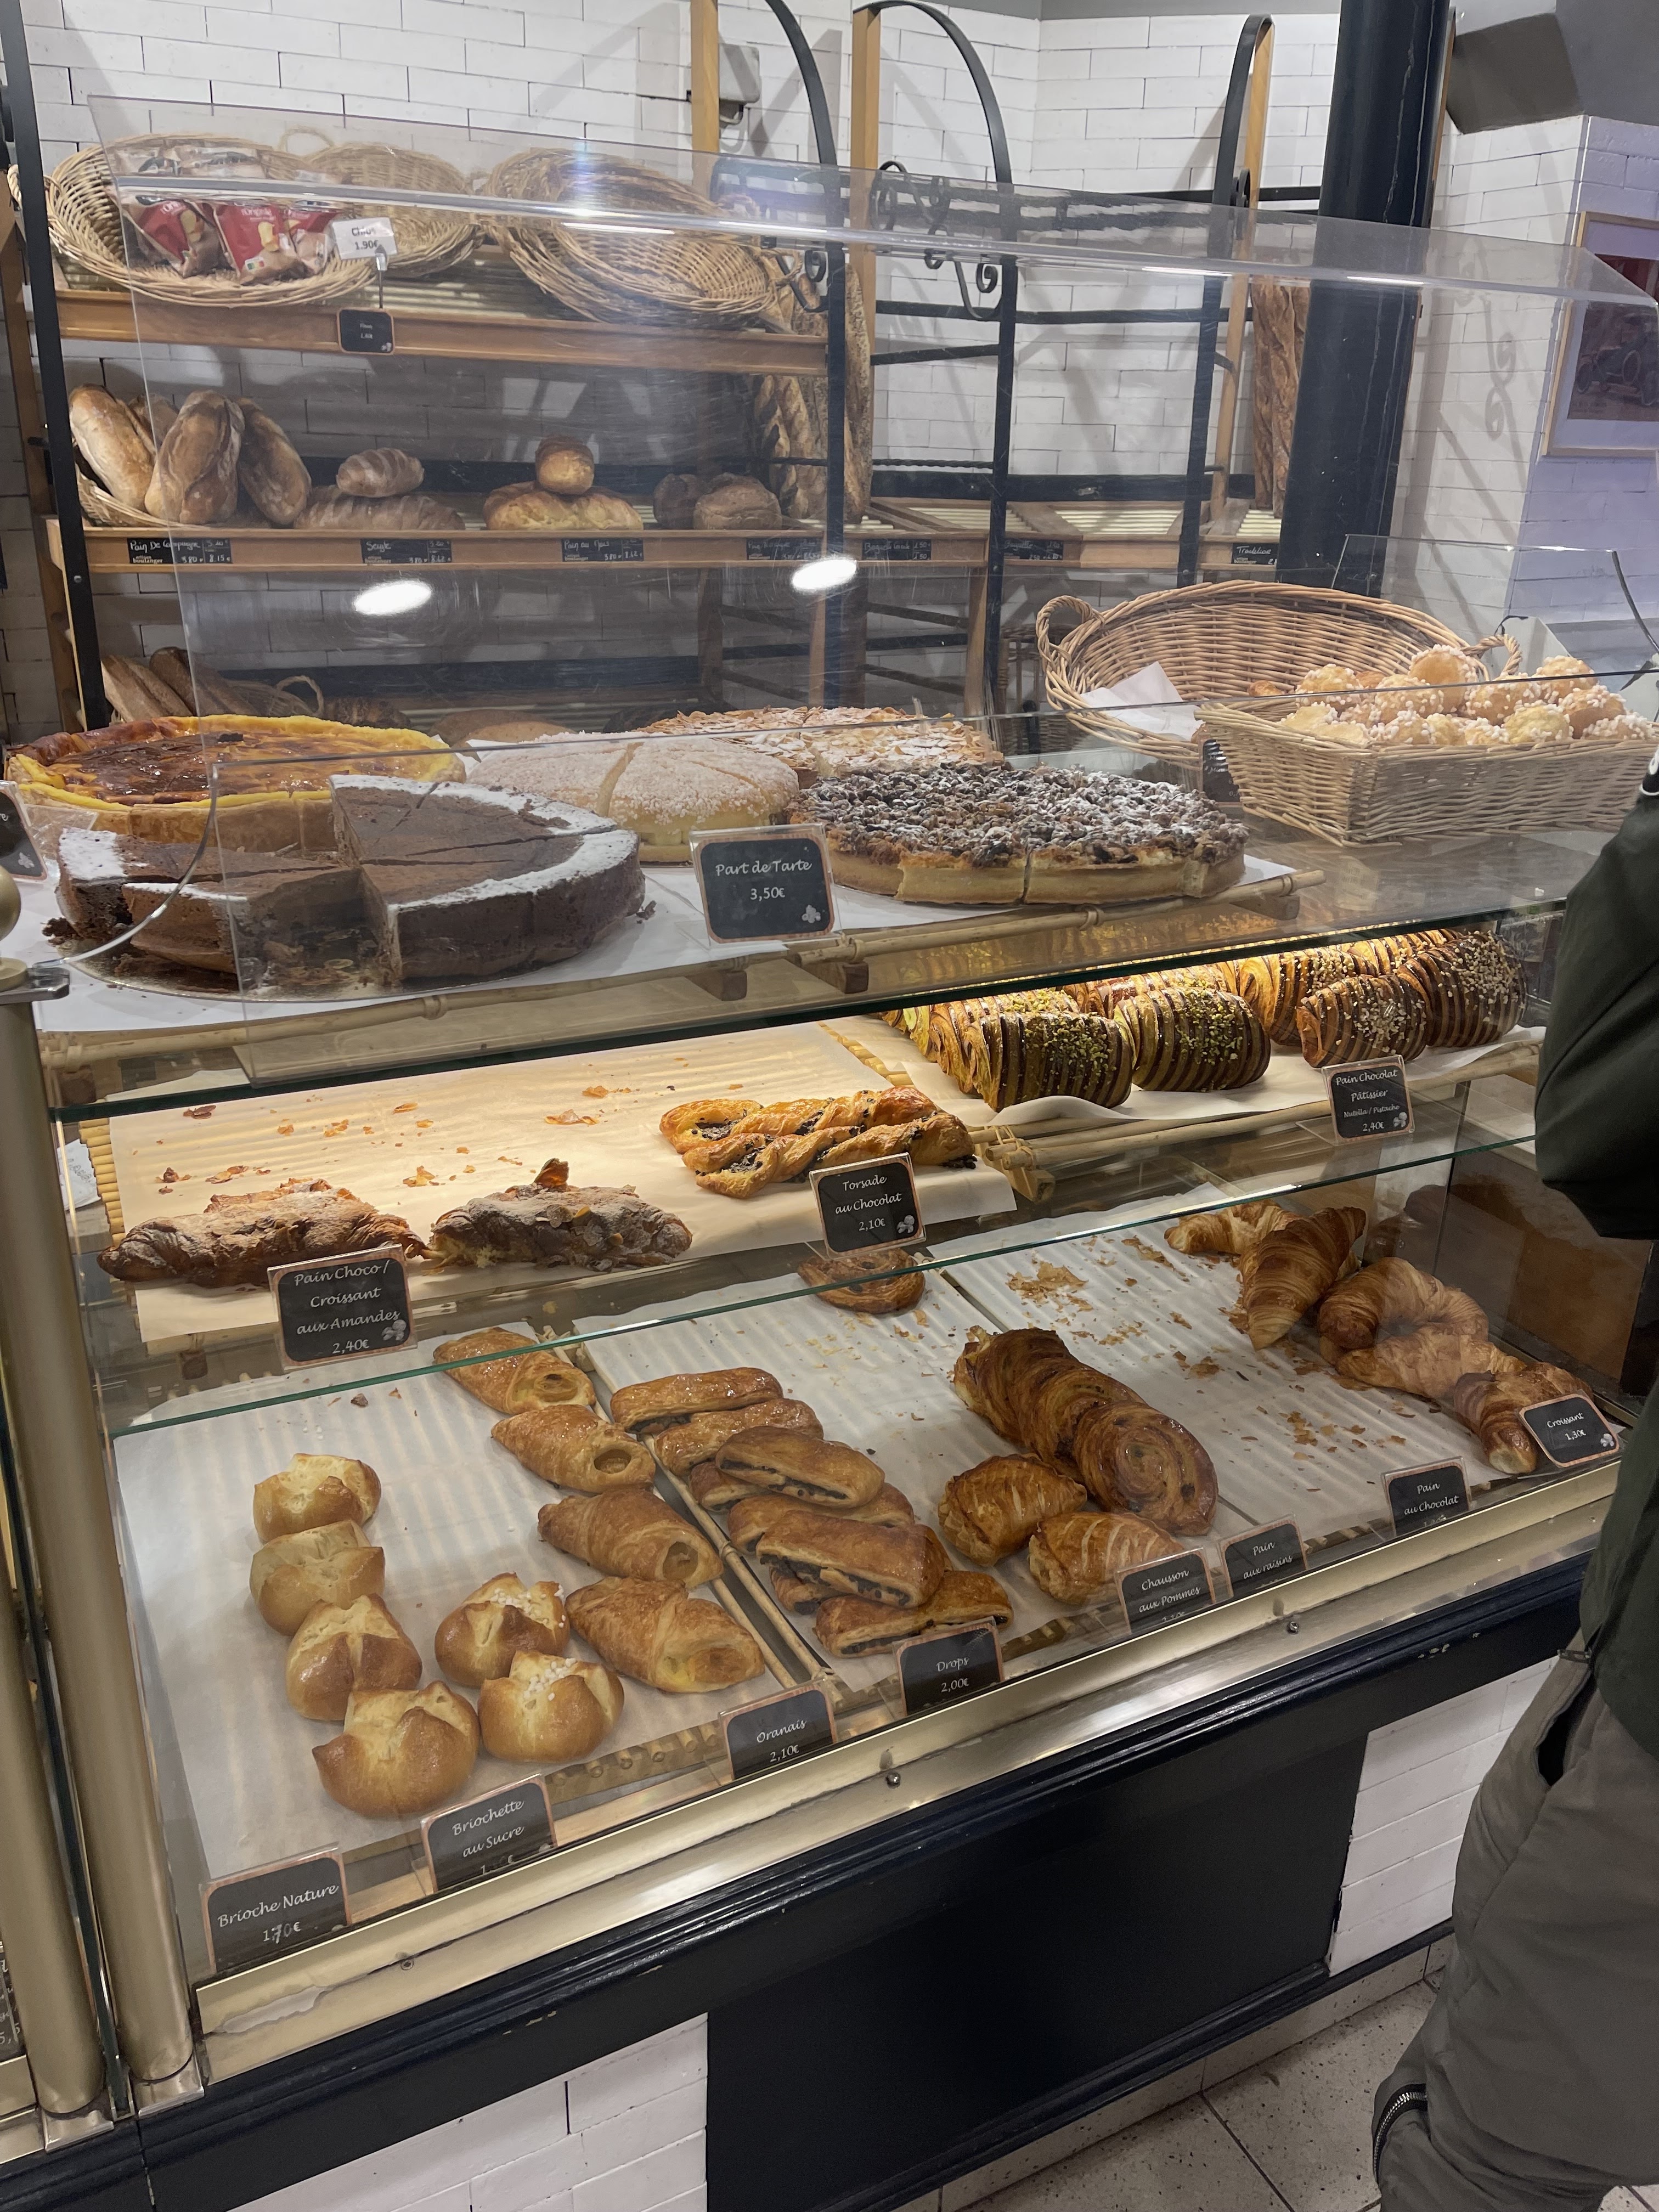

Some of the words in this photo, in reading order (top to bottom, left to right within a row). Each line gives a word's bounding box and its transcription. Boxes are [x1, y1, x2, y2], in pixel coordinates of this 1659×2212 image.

[715, 862, 749, 876] Part
[752, 860, 771, 873] de
[772, 859, 812, 872] Tarte
[750, 887, 785, 901] 3,50€
[1336, 1075, 1358, 1086] Pain
[1359, 1069, 1398, 1082] Chocolat
[1351, 1090, 1389, 1102] Pâtissier
[1344, 1109, 1368, 1118] Nutella
[1373, 1104, 1400, 1114] Pistache
[1362, 1121, 1385, 1132] 2,40€
[842, 1175, 887, 1191] Torsade
[835, 1206, 853, 1214] au
[853, 1192, 902, 1211] Chocolat
[858, 1218, 885, 1231] 2,10€
[294, 1271, 334, 1286] Pain
[335, 1264, 382, 1279] Choco
[310, 1286, 382, 1308] Croissant
[296, 1321, 329, 1335] aux
[330, 1309, 400, 1329] Amandes
[332, 1339, 369, 1354] 2,40€
[1547, 1412, 1584, 1428] Croissant
[1565, 1429, 1587, 1441] 1,30€
[1417, 1482, 1441, 1494] Pain
[1404, 1507, 1418, 1515] au
[1419, 1495, 1460, 1512] Chocolat
[1252, 1541, 1276, 1556] Pain
[1243, 1567, 1262, 1579] aux
[1263, 1555, 1293, 1572] raisins
[1142, 1569, 1189, 1590] Chausson
[1139, 1601, 1161, 1612] aux
[1161, 1587, 1201, 1606] Pommes
[936, 1657, 970, 1672] Drops
[941, 1678, 969, 1692] 2,00€
[756, 1719, 807, 1743] Oranais
[770, 1745, 800, 1763] 2,10€
[452, 1800, 525, 1836] Briochette
[462, 1843, 485, 1858] au
[486, 1826, 525, 1849] Sucre
[217, 1901, 281, 1927] Brioche
[283, 1884, 340, 1909] Nature
